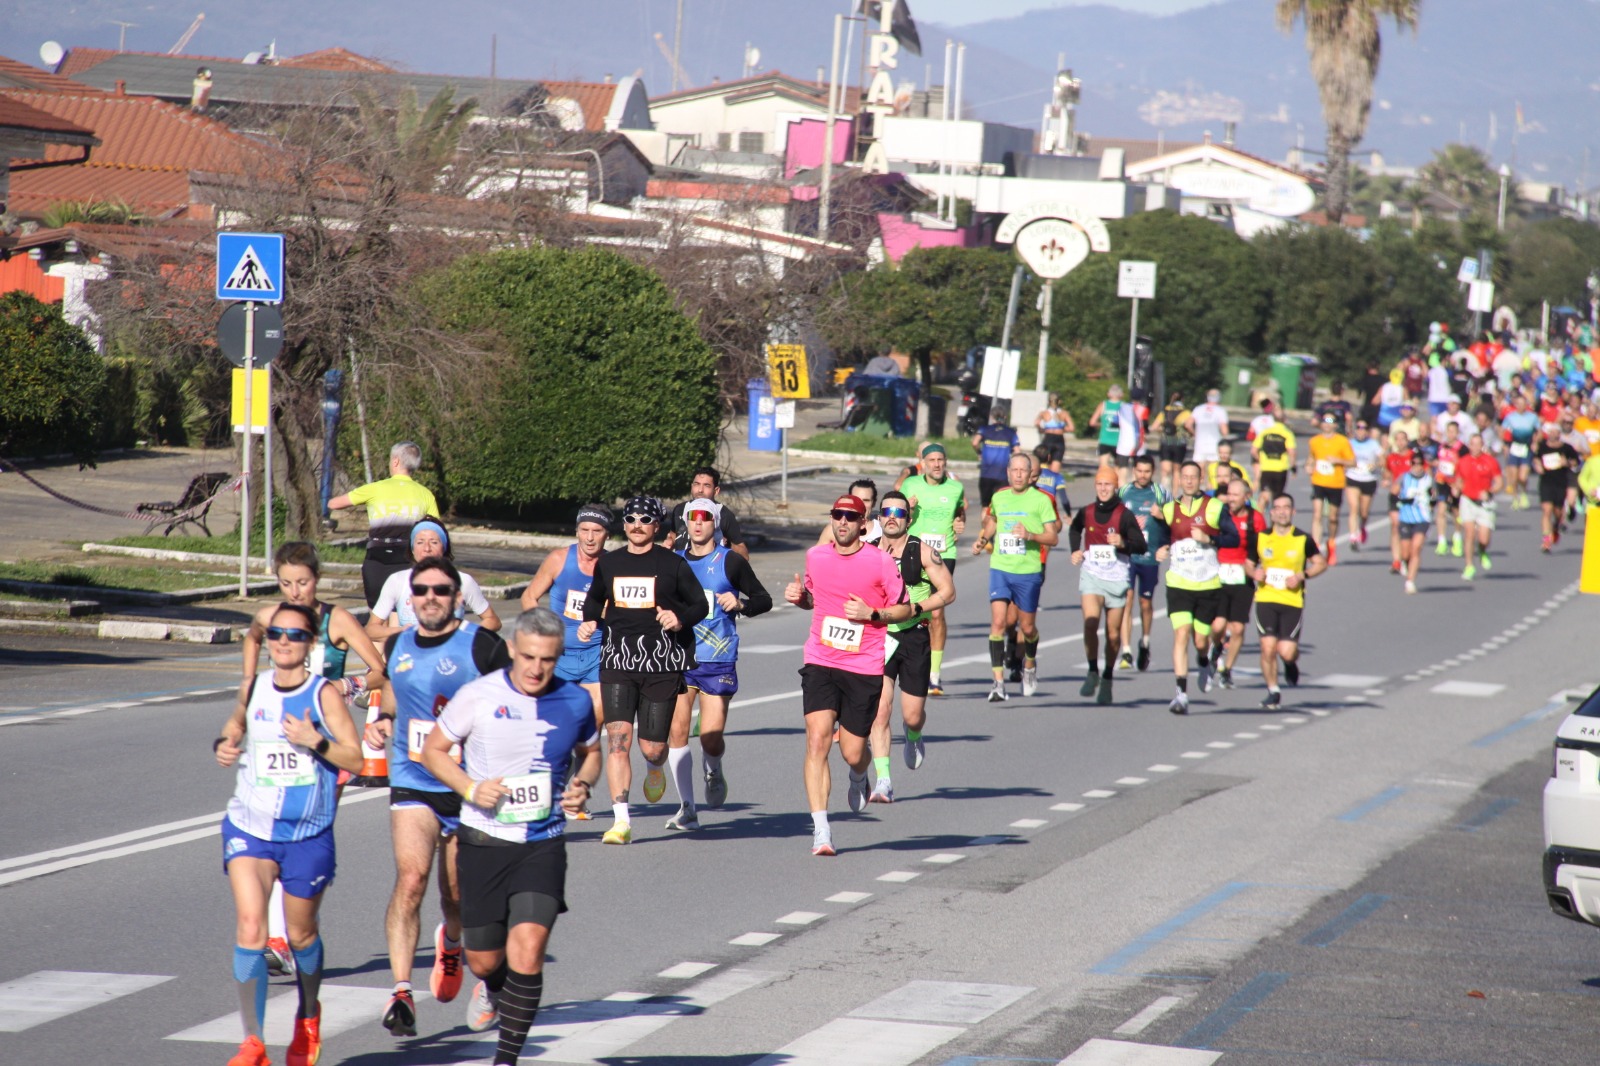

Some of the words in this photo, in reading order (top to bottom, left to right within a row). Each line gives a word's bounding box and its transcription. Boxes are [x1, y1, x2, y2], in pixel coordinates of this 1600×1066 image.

[776, 360, 799, 392] 13
[1094, 550, 1111, 560] 545
[620, 586, 647, 598] 1773
[572, 598, 586, 611] 15
[829, 625, 855, 641] 1772
[1580, 727, 1600, 737] RA
[267, 752, 298, 770] 216
